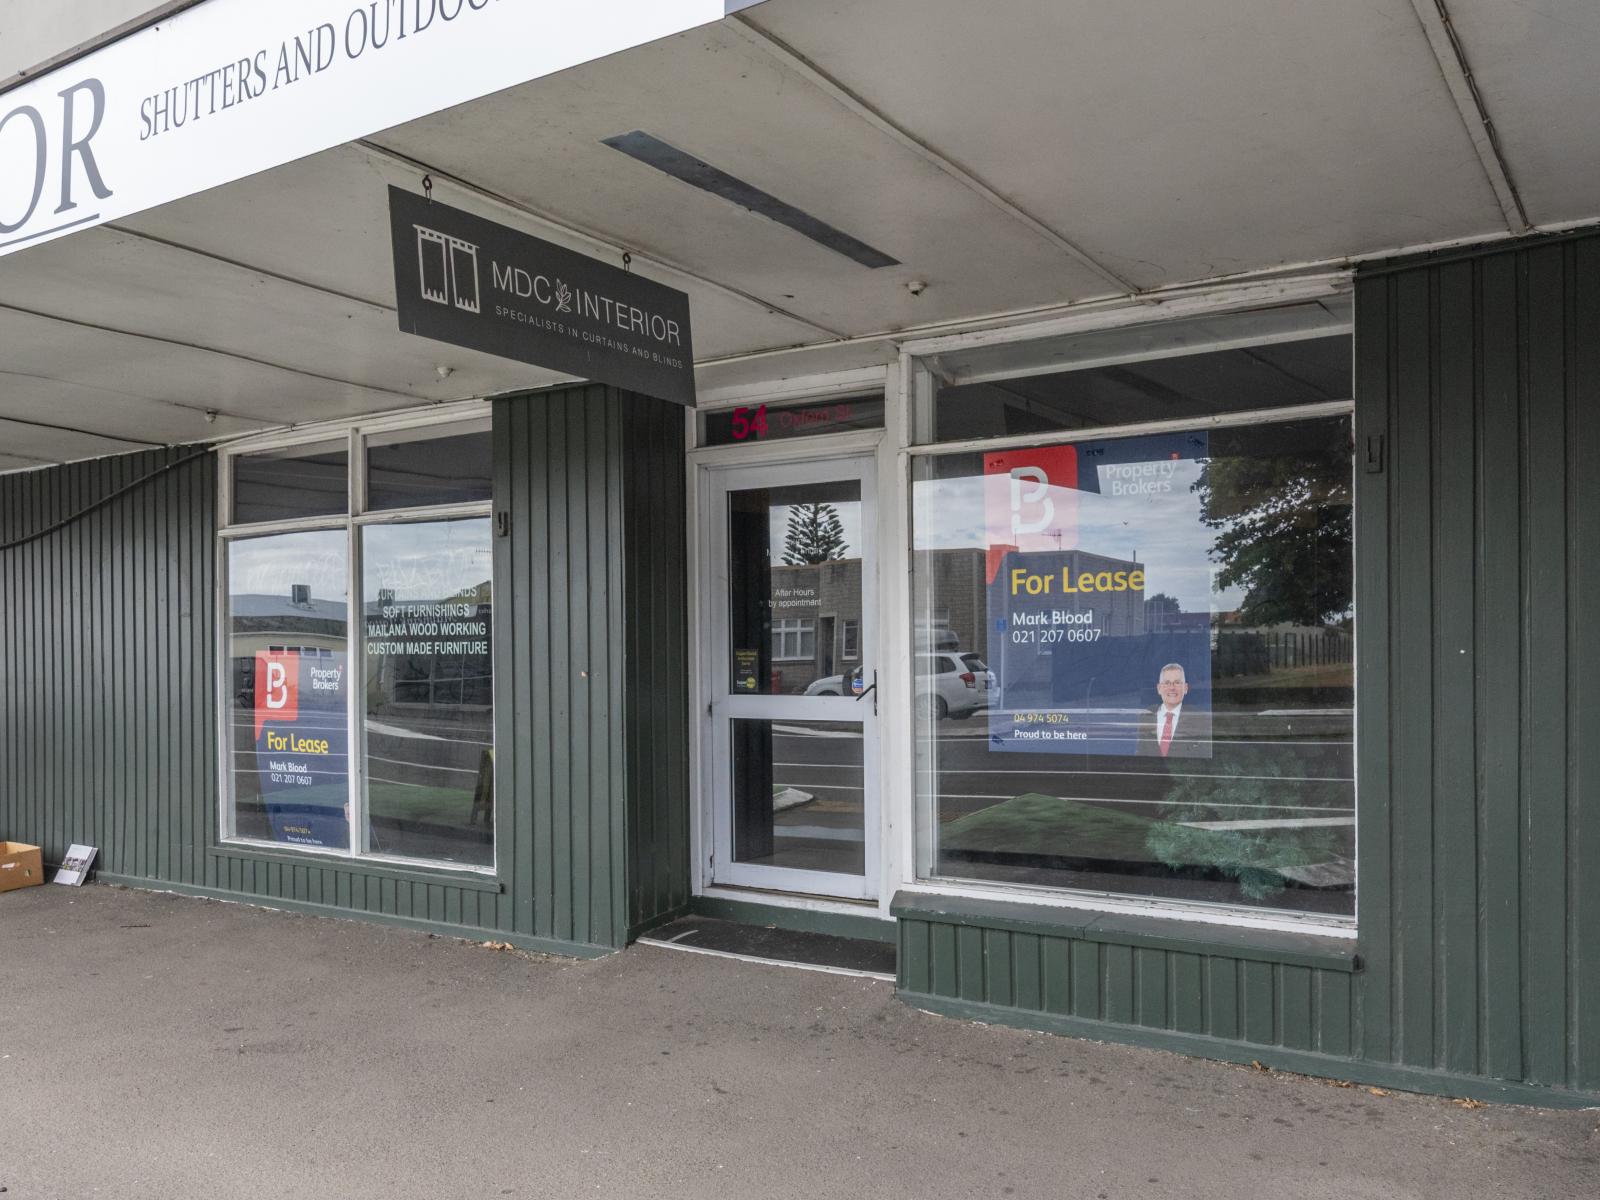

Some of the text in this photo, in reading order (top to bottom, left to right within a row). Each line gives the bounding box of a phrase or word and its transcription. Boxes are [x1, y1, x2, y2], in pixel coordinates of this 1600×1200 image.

[140, 0, 500, 141] SHUTTERS AND OUTD
[492, 260, 681, 347] MDC INTERIOR
[495, 305, 683, 369] SPECIALISTS IN CURTAINS AND BLINDS
[732, 404, 769, 440] 54
[1105, 459, 1177, 481] Property
[1112, 478, 1172, 496] Brokers
[1011, 566, 1145, 595] For Lease
[775, 588, 815, 597] After Hours
[768, 599, 822, 608] by appointment
[383, 605, 405, 618] SOFT
[408, 604, 470, 618] FURNISHINGS
[1012, 609, 1093, 626] Mark Blood
[368, 622, 486, 637] MAILANA WOOD WORKING
[1012, 629, 1101, 643] 021 207 0607
[367, 641, 488, 655] CUSTOM MADE FURNITURE
[310, 667, 342, 681] Property
[312, 678, 339, 690] Brokers
[1014, 713, 1069, 723] 04 974 5074
[1014, 729, 1088, 740] Proud to be here
[267, 731, 329, 754] For Lease
[269, 760, 308, 773] Mark Blood
[271, 773, 313, 786] 021 207 0607
